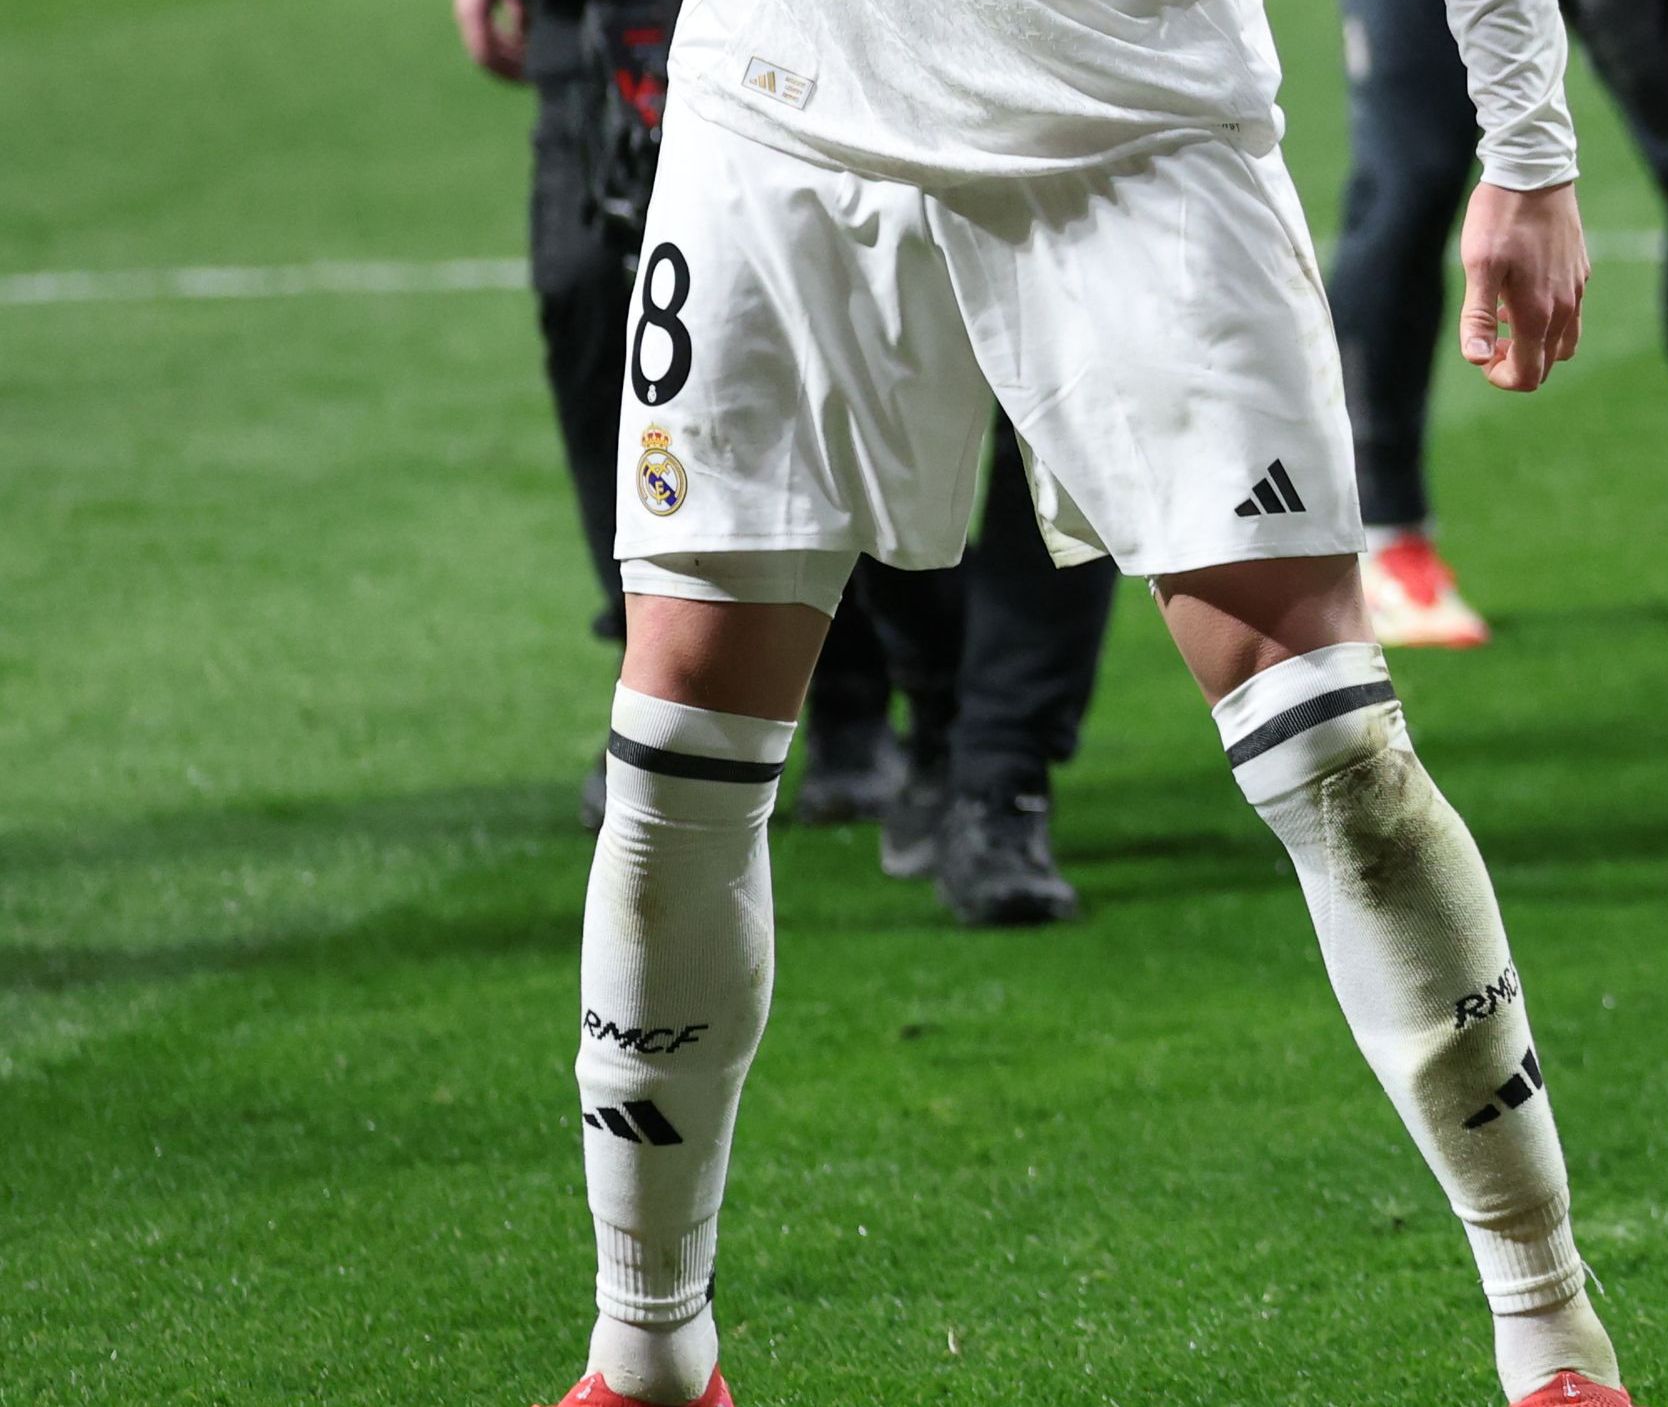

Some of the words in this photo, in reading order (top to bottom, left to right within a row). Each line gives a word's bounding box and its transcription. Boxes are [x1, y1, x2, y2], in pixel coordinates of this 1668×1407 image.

[631, 242, 693, 407] 8
[1455, 958, 1518, 1029] RMC
[583, 1009, 709, 1054] RMCF
